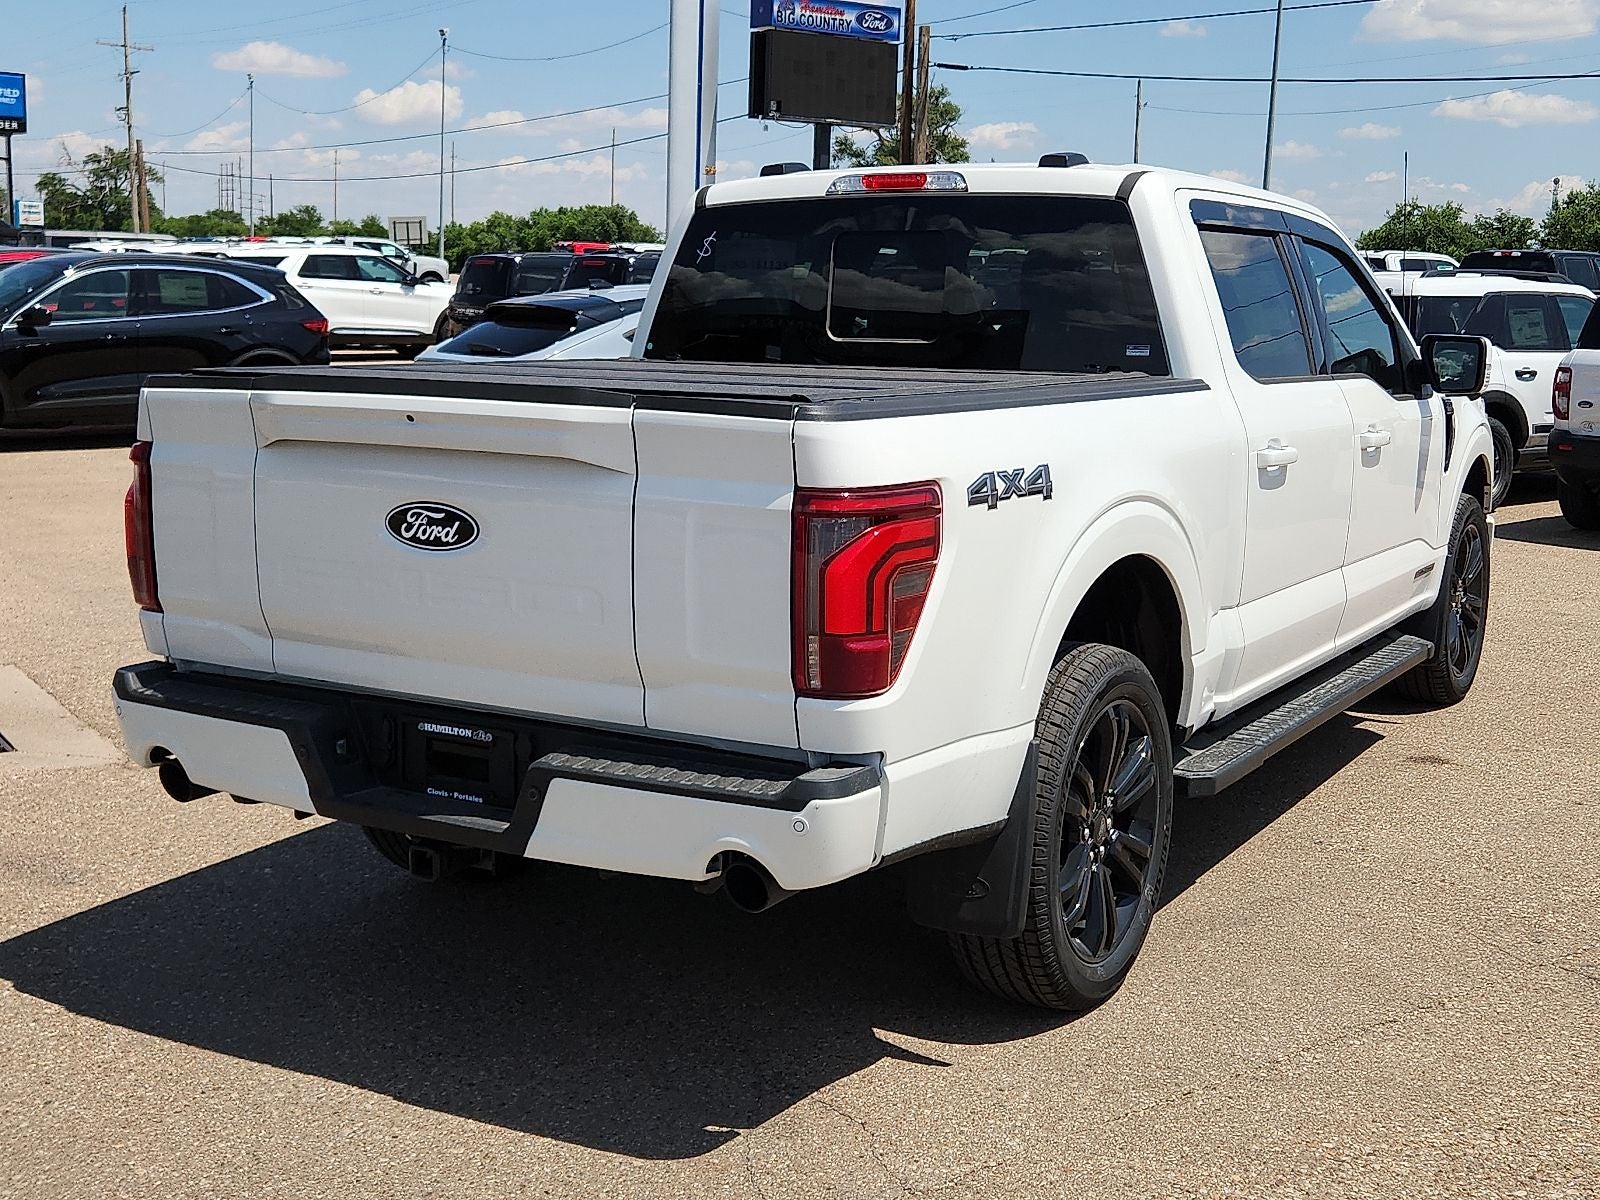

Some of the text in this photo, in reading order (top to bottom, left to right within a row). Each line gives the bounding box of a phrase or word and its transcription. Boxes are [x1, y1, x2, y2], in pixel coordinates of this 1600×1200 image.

[776, 9, 853, 32] BIG COUNTRY
[862, 12, 888, 30] Ford
[696, 230, 717, 264] $
[400, 508, 460, 543] Ford
[424, 722, 473, 738] HAMILTON
[426, 787, 483, 803] Clovis Portales
